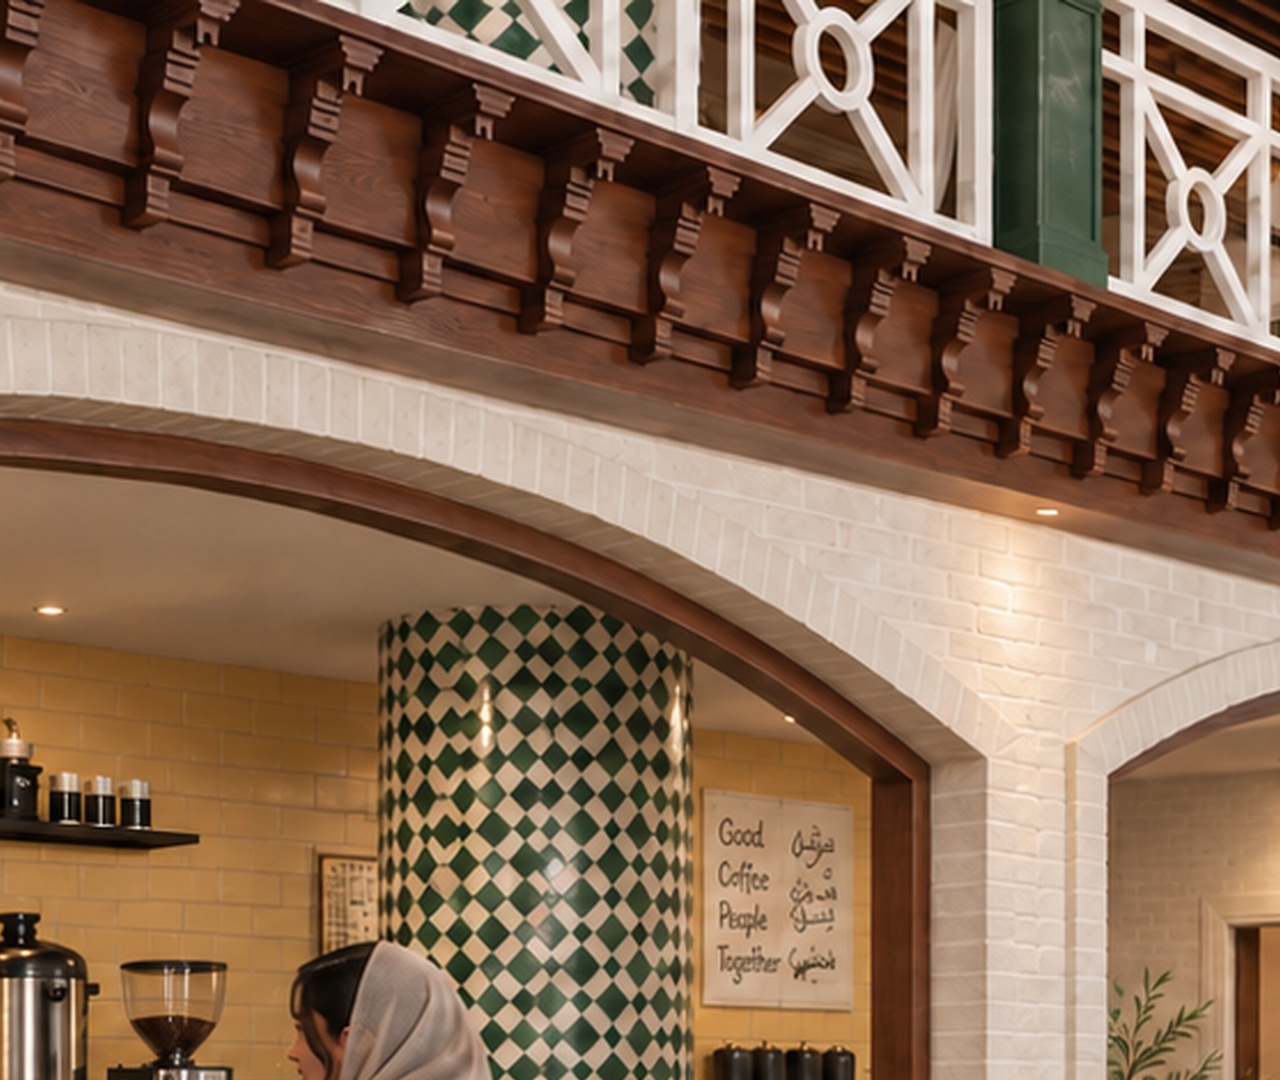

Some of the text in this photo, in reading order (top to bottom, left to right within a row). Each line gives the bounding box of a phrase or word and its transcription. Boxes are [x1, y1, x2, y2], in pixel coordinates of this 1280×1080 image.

[718, 817, 765, 849] Good
[718, 900, 768, 939] People
[717, 944, 782, 985] Together
